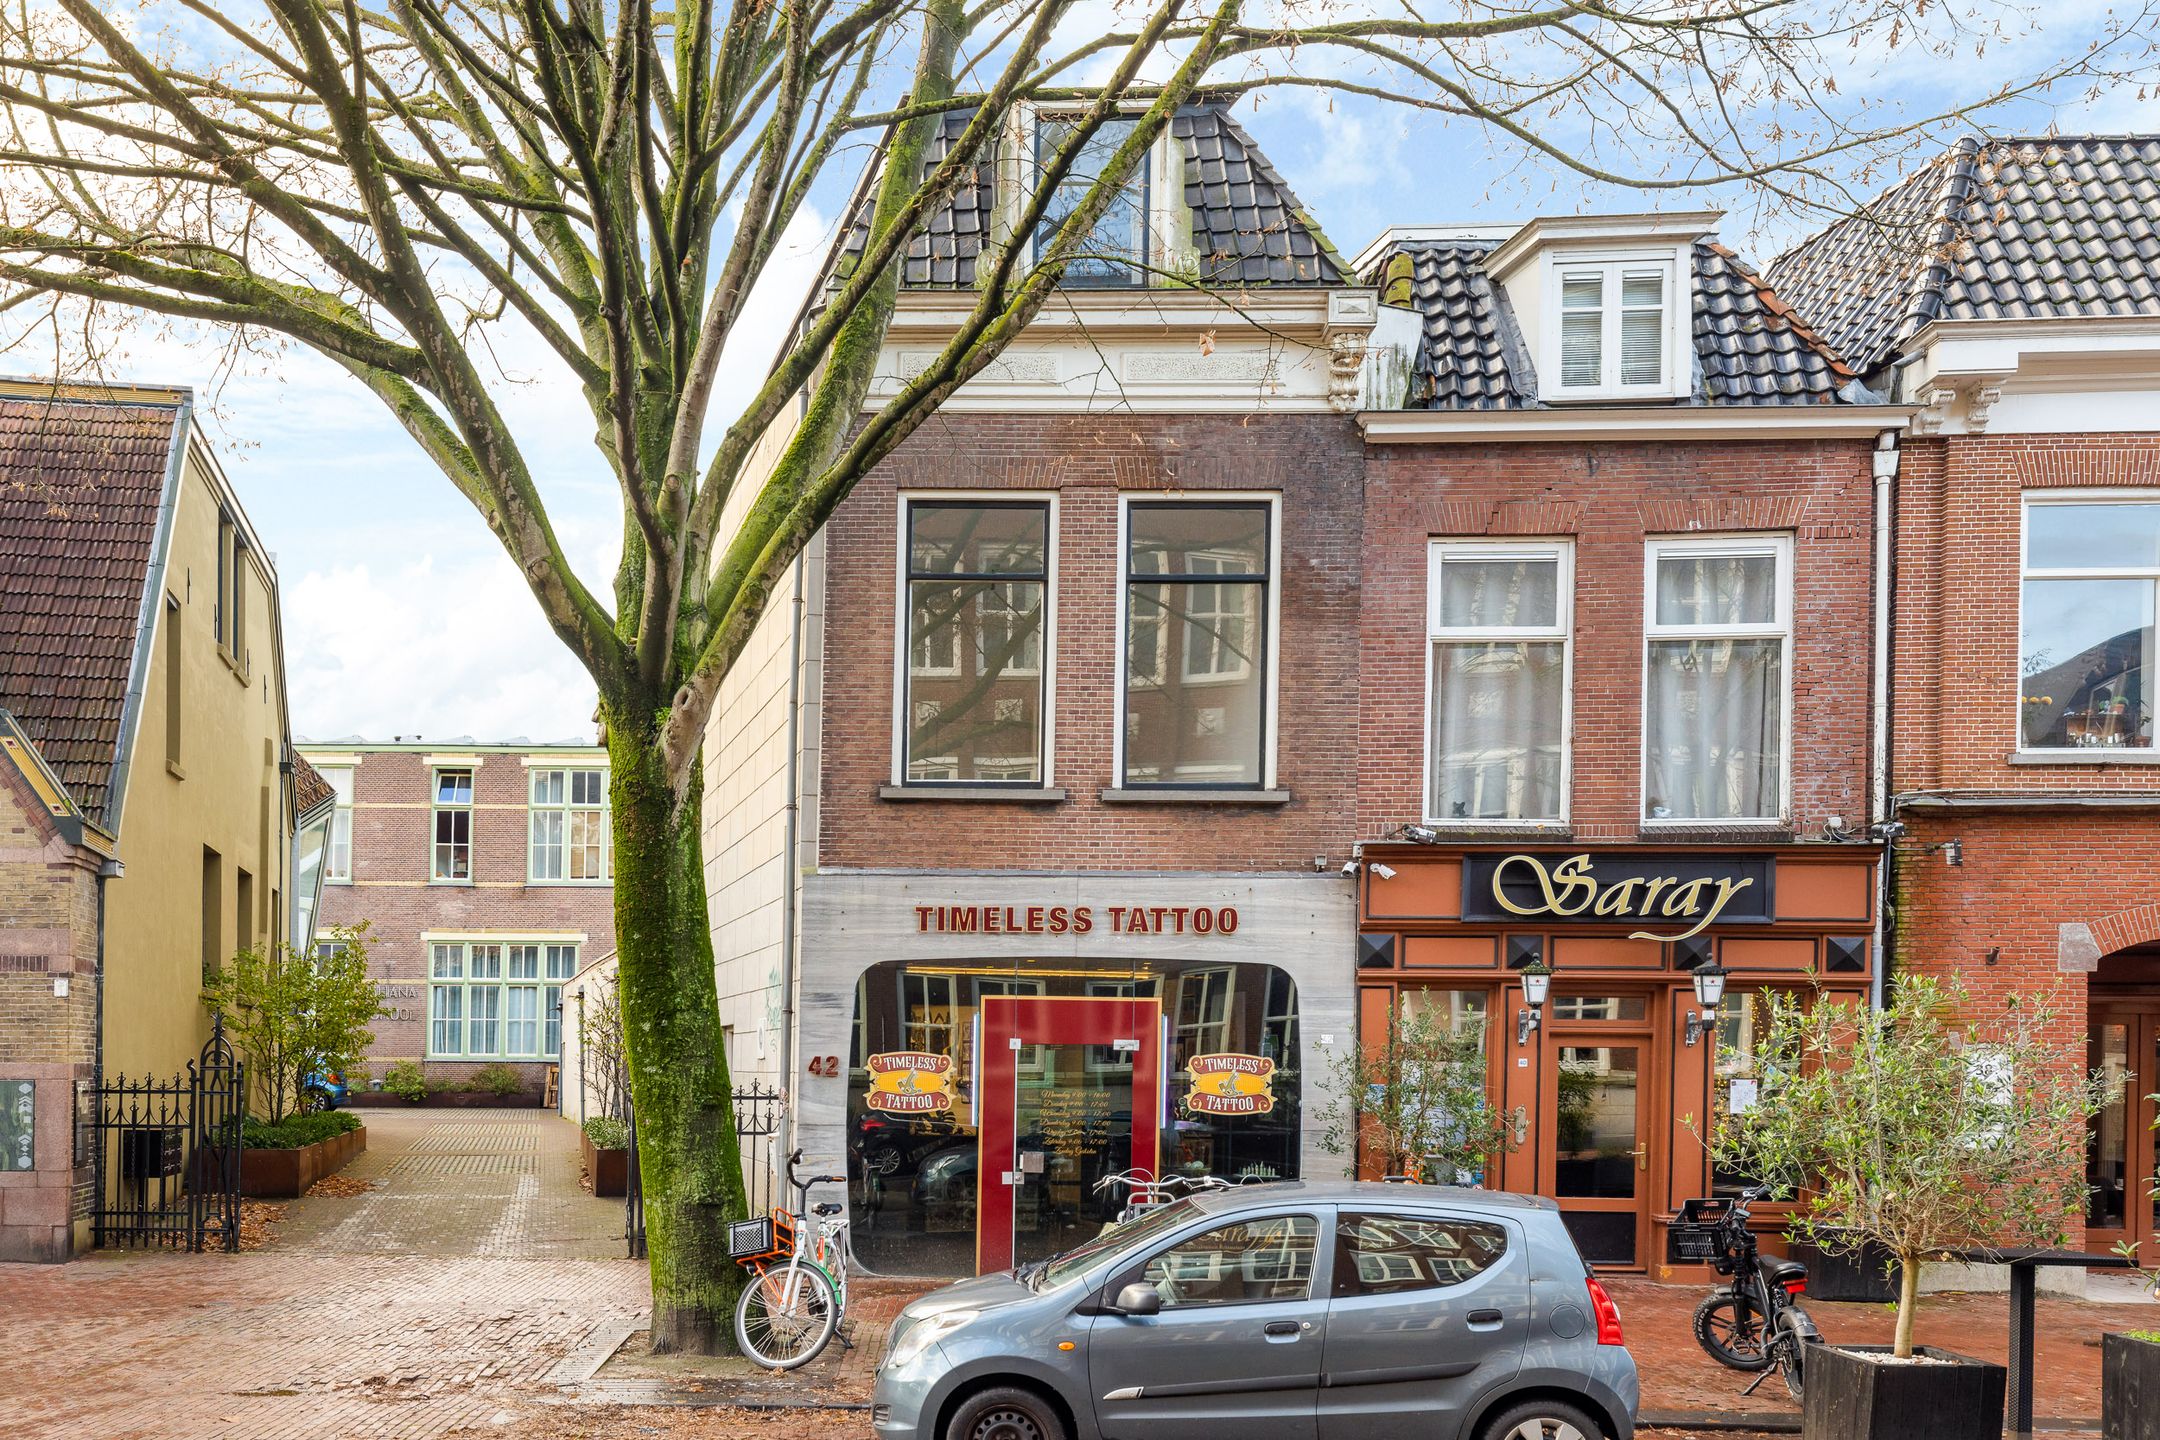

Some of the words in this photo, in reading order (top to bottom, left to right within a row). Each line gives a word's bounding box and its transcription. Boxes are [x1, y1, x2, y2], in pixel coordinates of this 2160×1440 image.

[1492, 853, 1754, 941] Saray
[914, 906, 1093, 934] TIMELESS
[1107, 906, 1239, 934] TATTOO
[808, 1055, 839, 1077] 42
[883, 1056, 937, 1071] TIMELESS
[1205, 1057, 1259, 1073] TIMELESS
[886, 1093, 933, 1109] TATTOO
[1207, 1095, 1254, 1111] TATTOO
[1697, 1308, 1710, 1340] KENDA
